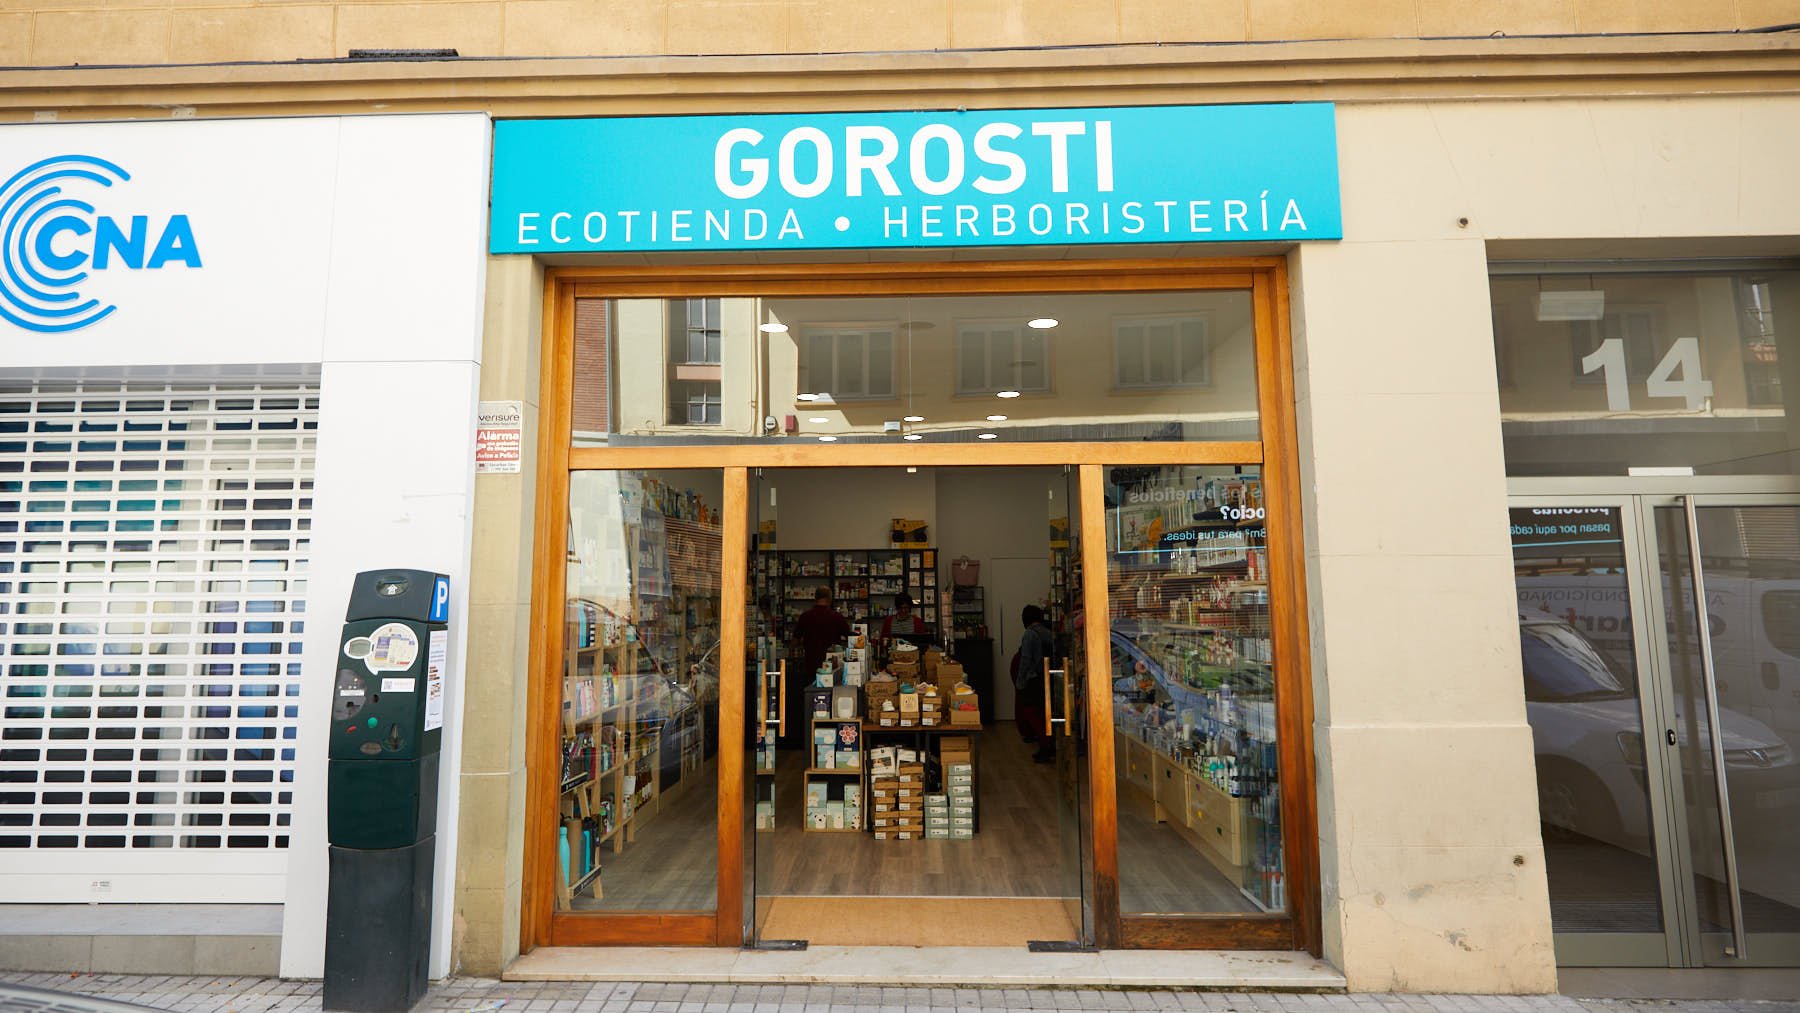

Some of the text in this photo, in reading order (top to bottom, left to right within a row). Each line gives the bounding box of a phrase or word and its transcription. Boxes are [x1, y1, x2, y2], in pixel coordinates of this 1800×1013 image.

[714, 120, 1114, 200] GOROSTI
[35, 214, 202, 270] CNA
[518, 191, 1307, 244] ECOTIENDA HERBORISTERÍA
[1582, 337, 1713, 411] 14
[477, 431, 519, 441] Alarma
[478, 414, 520, 422] verisure
[436, 580, 449, 618] P
